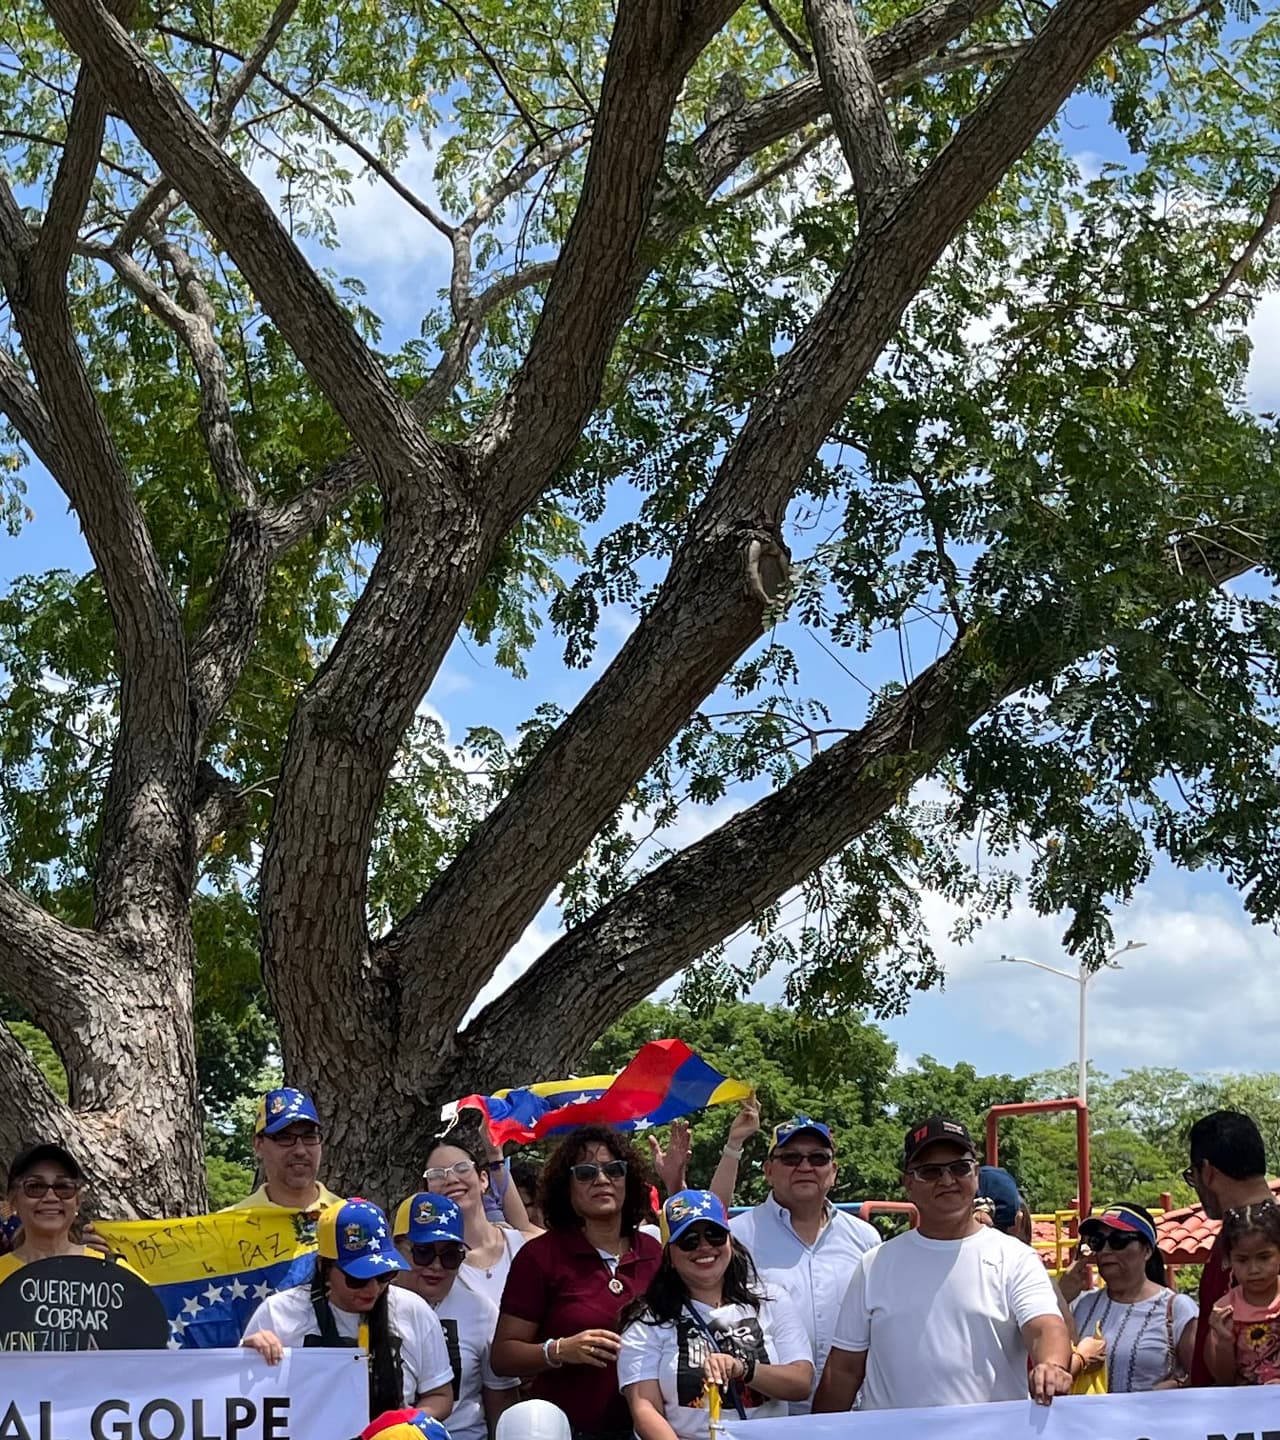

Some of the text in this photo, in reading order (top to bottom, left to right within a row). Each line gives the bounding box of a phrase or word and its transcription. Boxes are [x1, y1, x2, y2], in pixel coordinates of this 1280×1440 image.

[238, 1232, 291, 1268] PAZ
[20, 1278, 125, 1310] QUEREMOS
[35, 1304, 109, 1331] COBRAR
